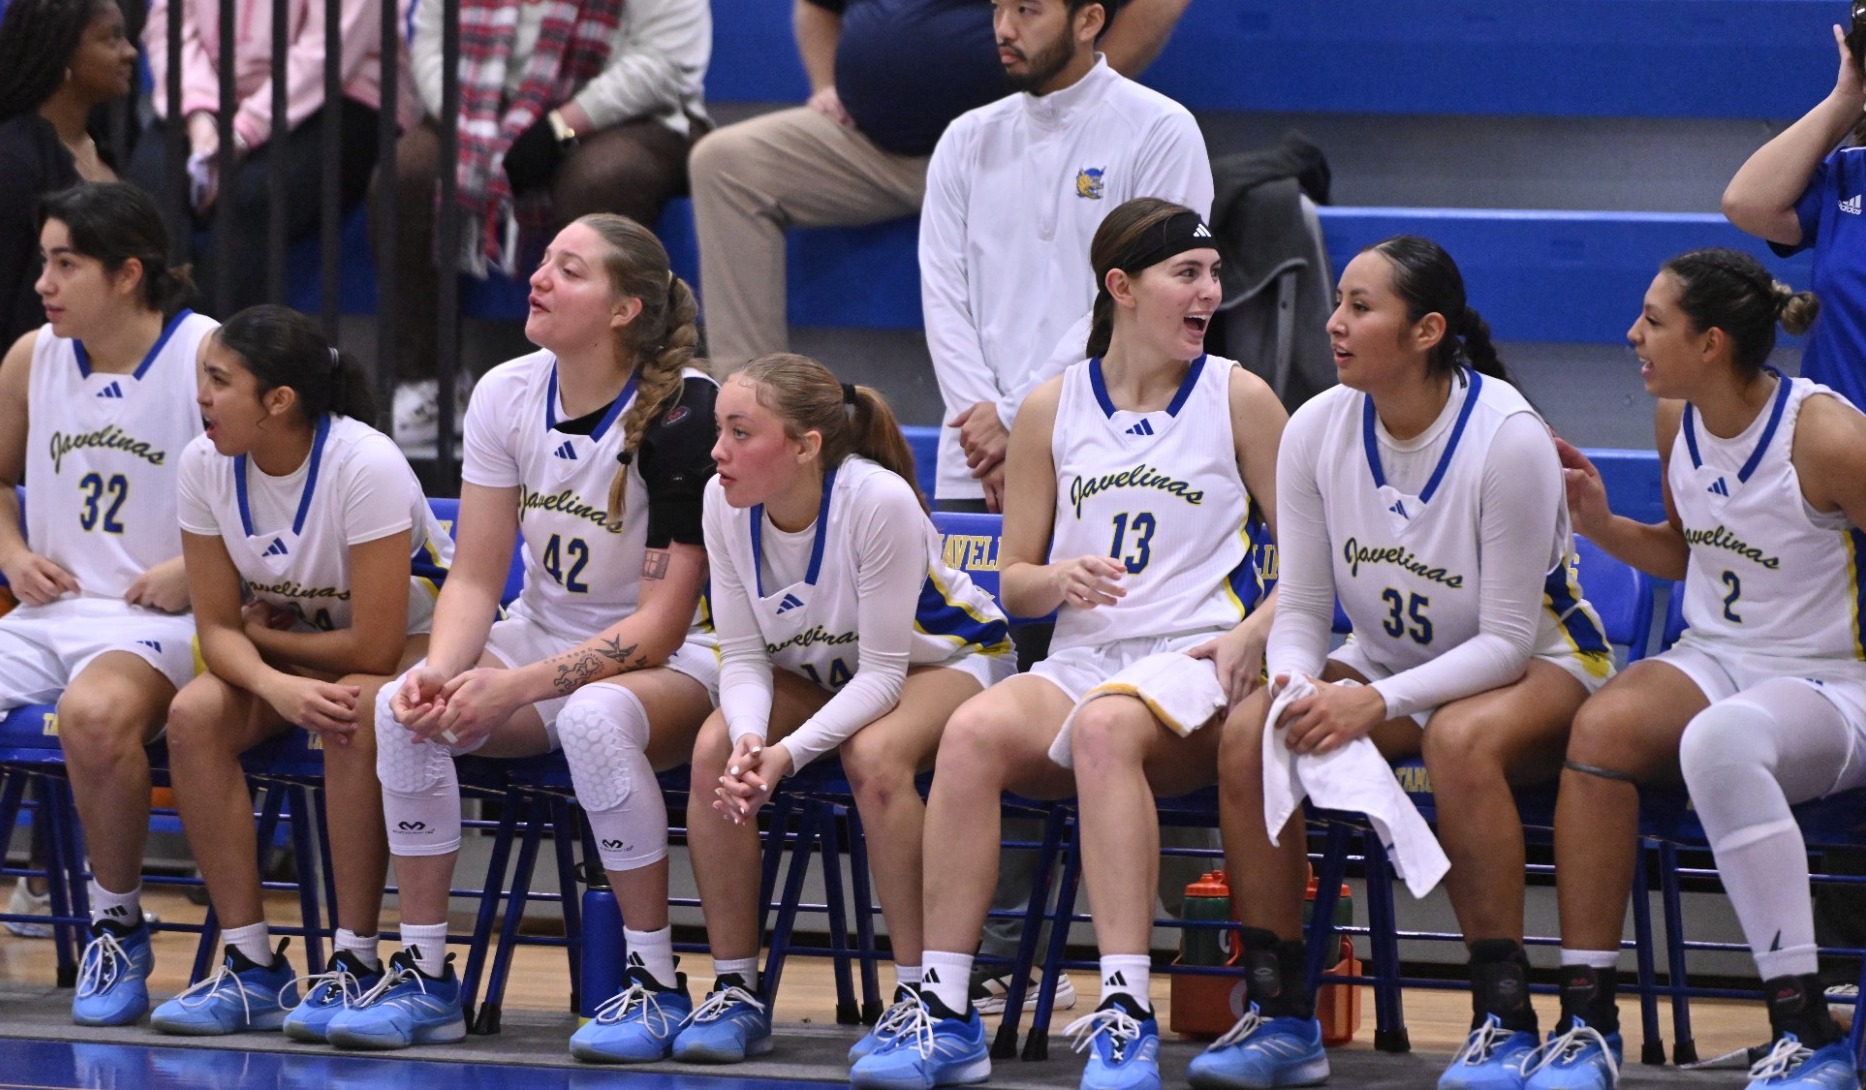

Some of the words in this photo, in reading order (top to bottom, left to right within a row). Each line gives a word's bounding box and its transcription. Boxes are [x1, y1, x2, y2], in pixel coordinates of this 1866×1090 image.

[49, 424, 166, 474] Javelinas
[79, 472, 129, 535] 32
[1070, 464, 1204, 519] Javelinas
[543, 534, 590, 594] 42
[1110, 511, 1157, 575] 13
[1344, 537, 1463, 589] Javelinas
[1684, 524, 1780, 570] avelinas
[248, 581, 351, 601] avelinas
[1381, 587, 1434, 646] 35
[1721, 569, 1743, 624] 2
[766, 624, 860, 654] avelina
